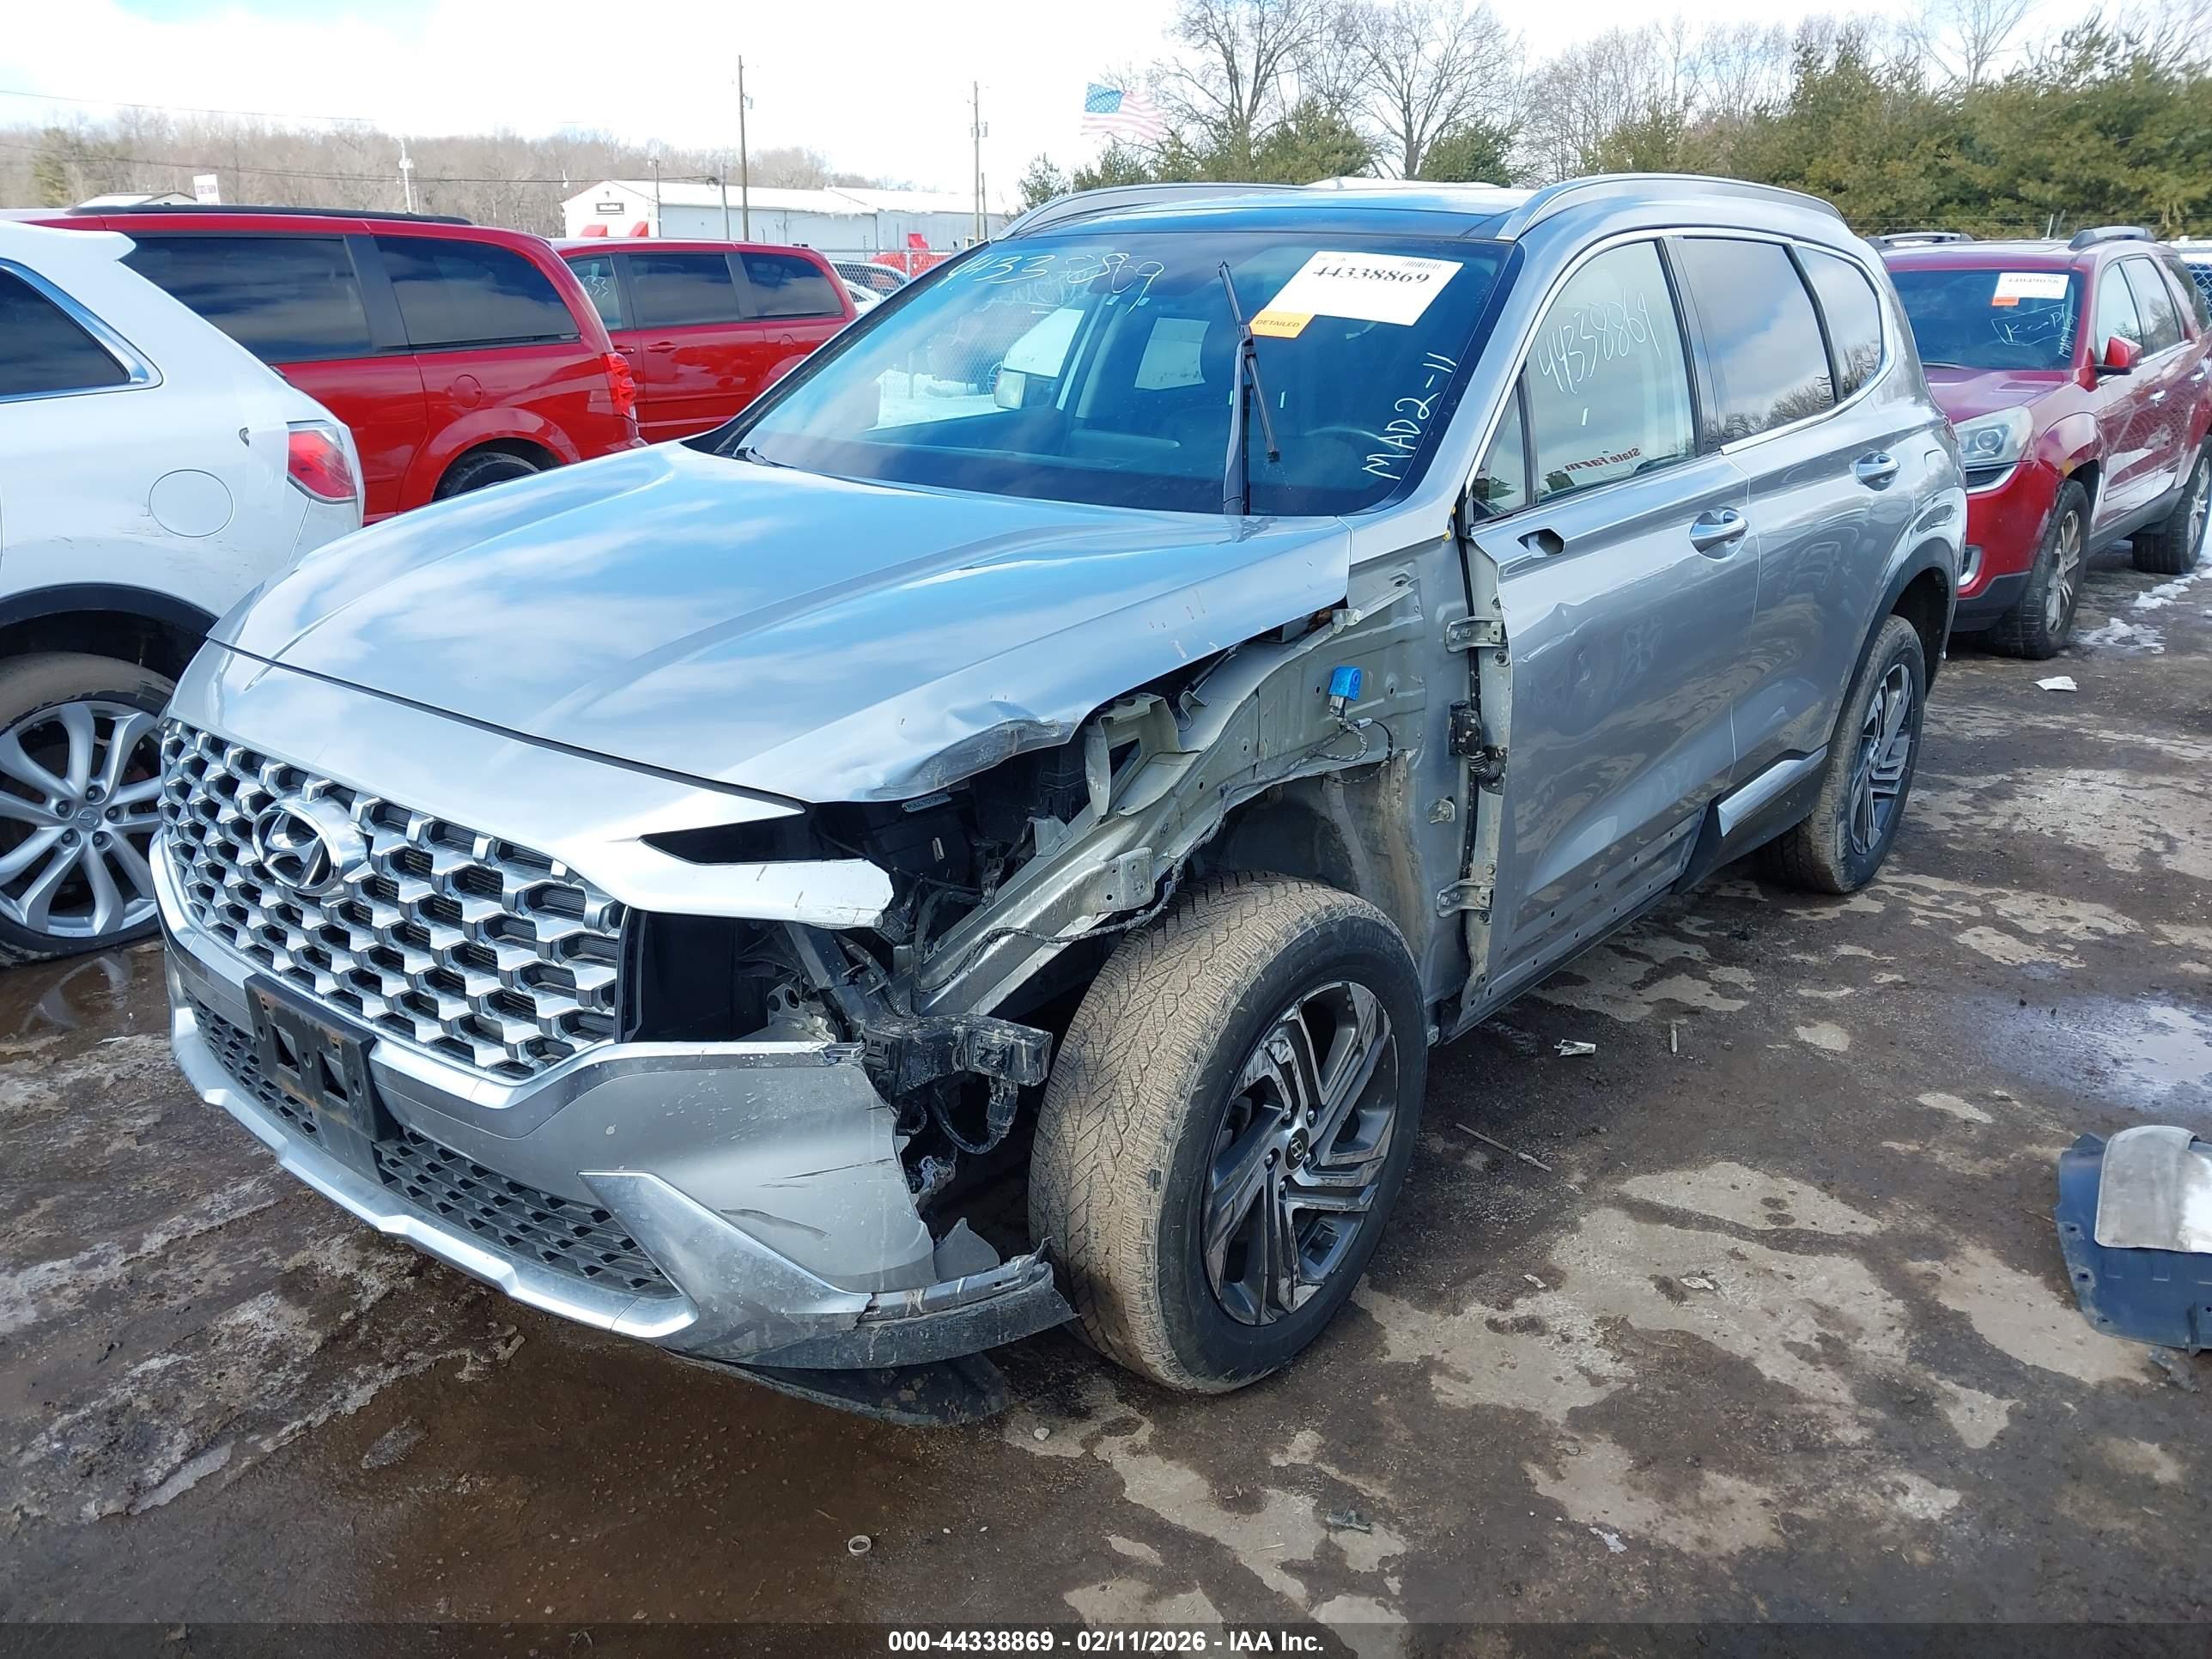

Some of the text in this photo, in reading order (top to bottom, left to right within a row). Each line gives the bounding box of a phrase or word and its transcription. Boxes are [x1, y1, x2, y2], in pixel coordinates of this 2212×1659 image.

[1313, 266, 1431, 284] 44338869
[1255, 319, 1300, 329] DETAILED
[1361, 351, 1457, 481] MAD2-11
